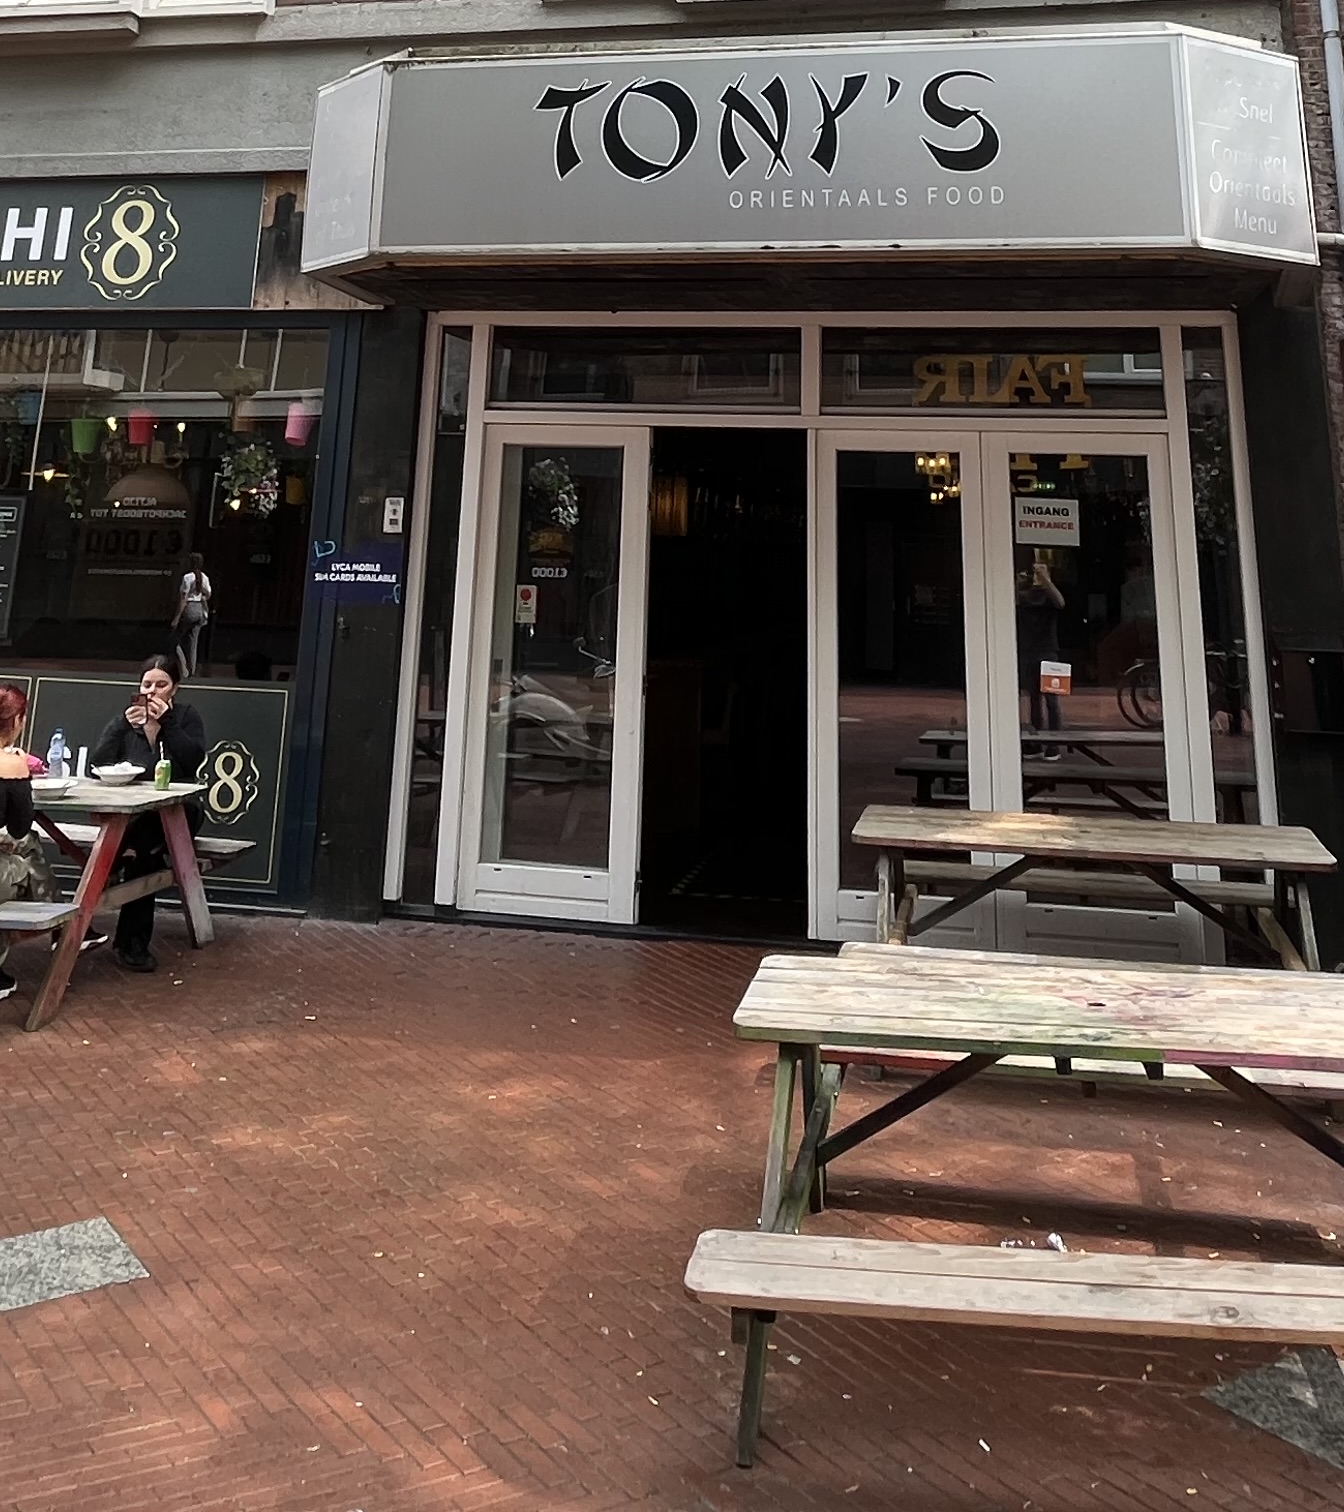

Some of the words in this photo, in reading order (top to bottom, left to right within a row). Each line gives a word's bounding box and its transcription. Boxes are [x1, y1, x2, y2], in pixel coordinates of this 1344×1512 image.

[1239, 96, 1274, 124] Snel
[533, 68, 1002, 183] TONY'S
[729, 186, 909, 209] ORIENTAALS
[927, 185, 1005, 206] FOOD
[1234, 207, 1277, 236] Menu
[101, 199, 155, 286] 8
[1022, 506, 1070, 517] INGANG
[1018, 520, 1074, 531] ENTRANCE
[329, 573, 355, 582] CARDS
[356, 573, 397, 583] AVAILABLE
[352, 563, 381, 572] MOBILE
[209, 752, 243, 814] 8
